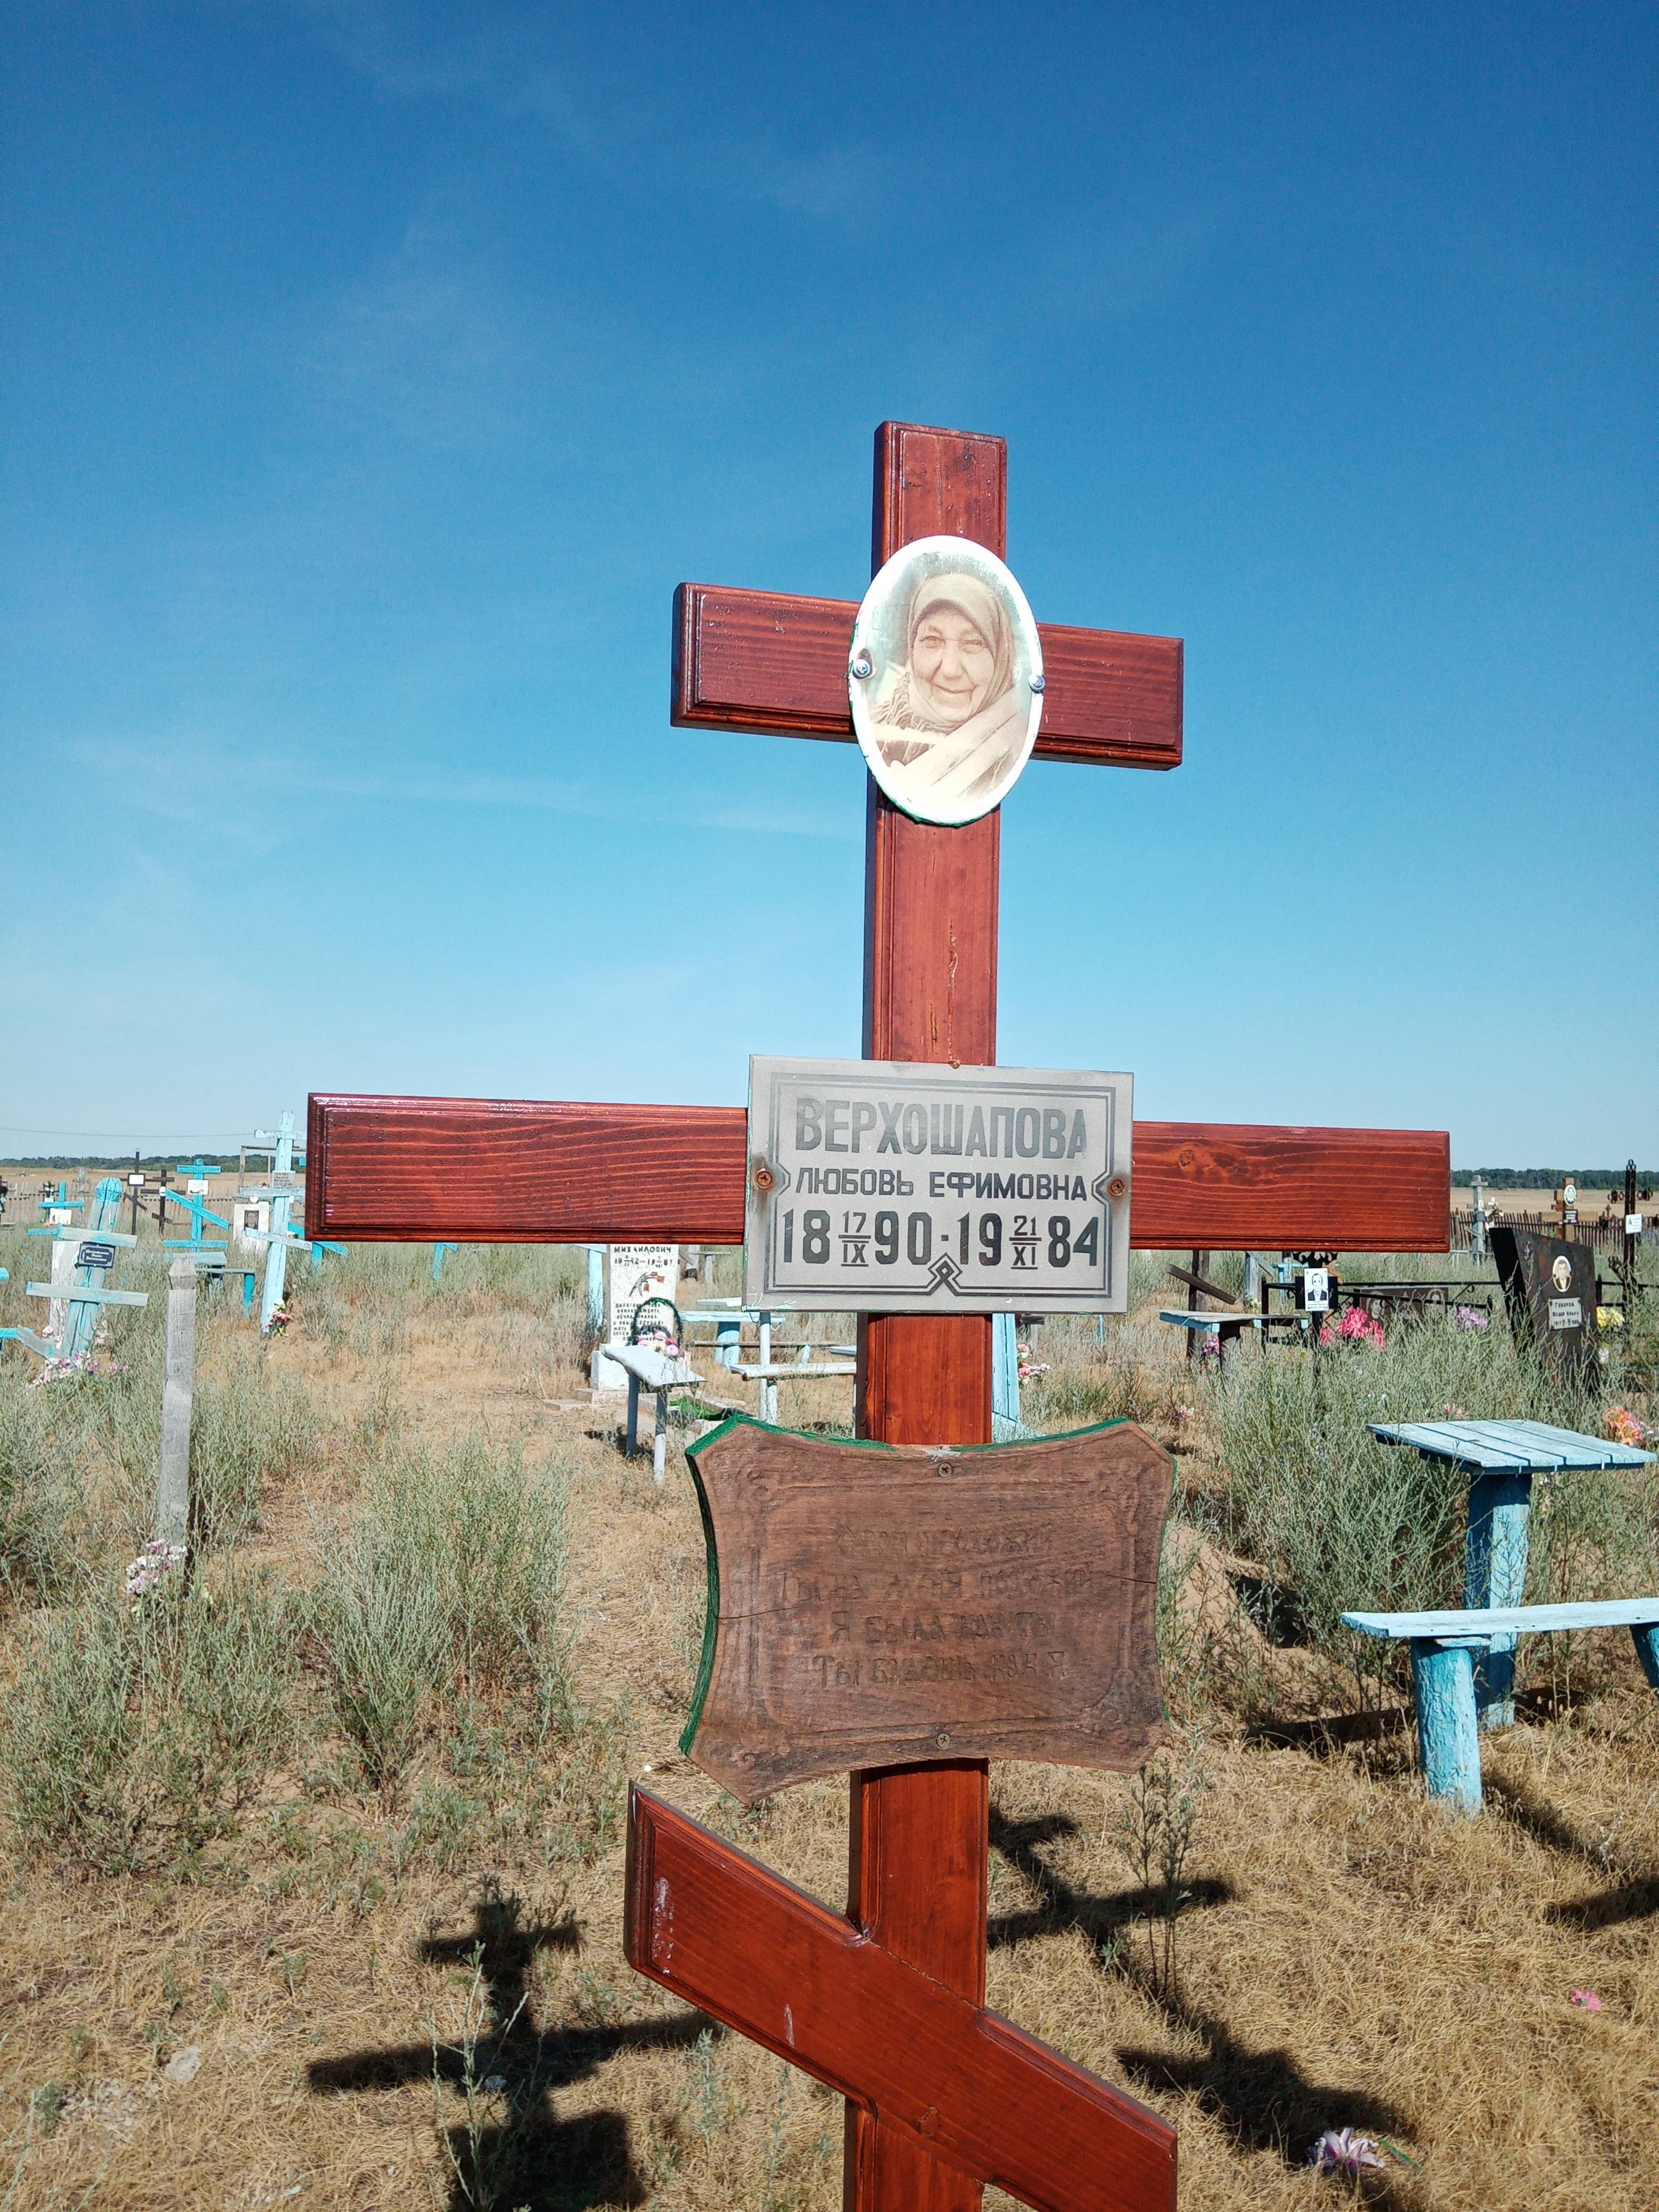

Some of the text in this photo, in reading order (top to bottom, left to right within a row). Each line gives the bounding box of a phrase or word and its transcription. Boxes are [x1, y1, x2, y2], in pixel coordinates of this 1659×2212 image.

[795, 1098, 1087, 1159] ВЕРХОШАПОВА
[795, 1167, 1087, 1201] ЛЮБОВЬ ЕФИМОВНА
